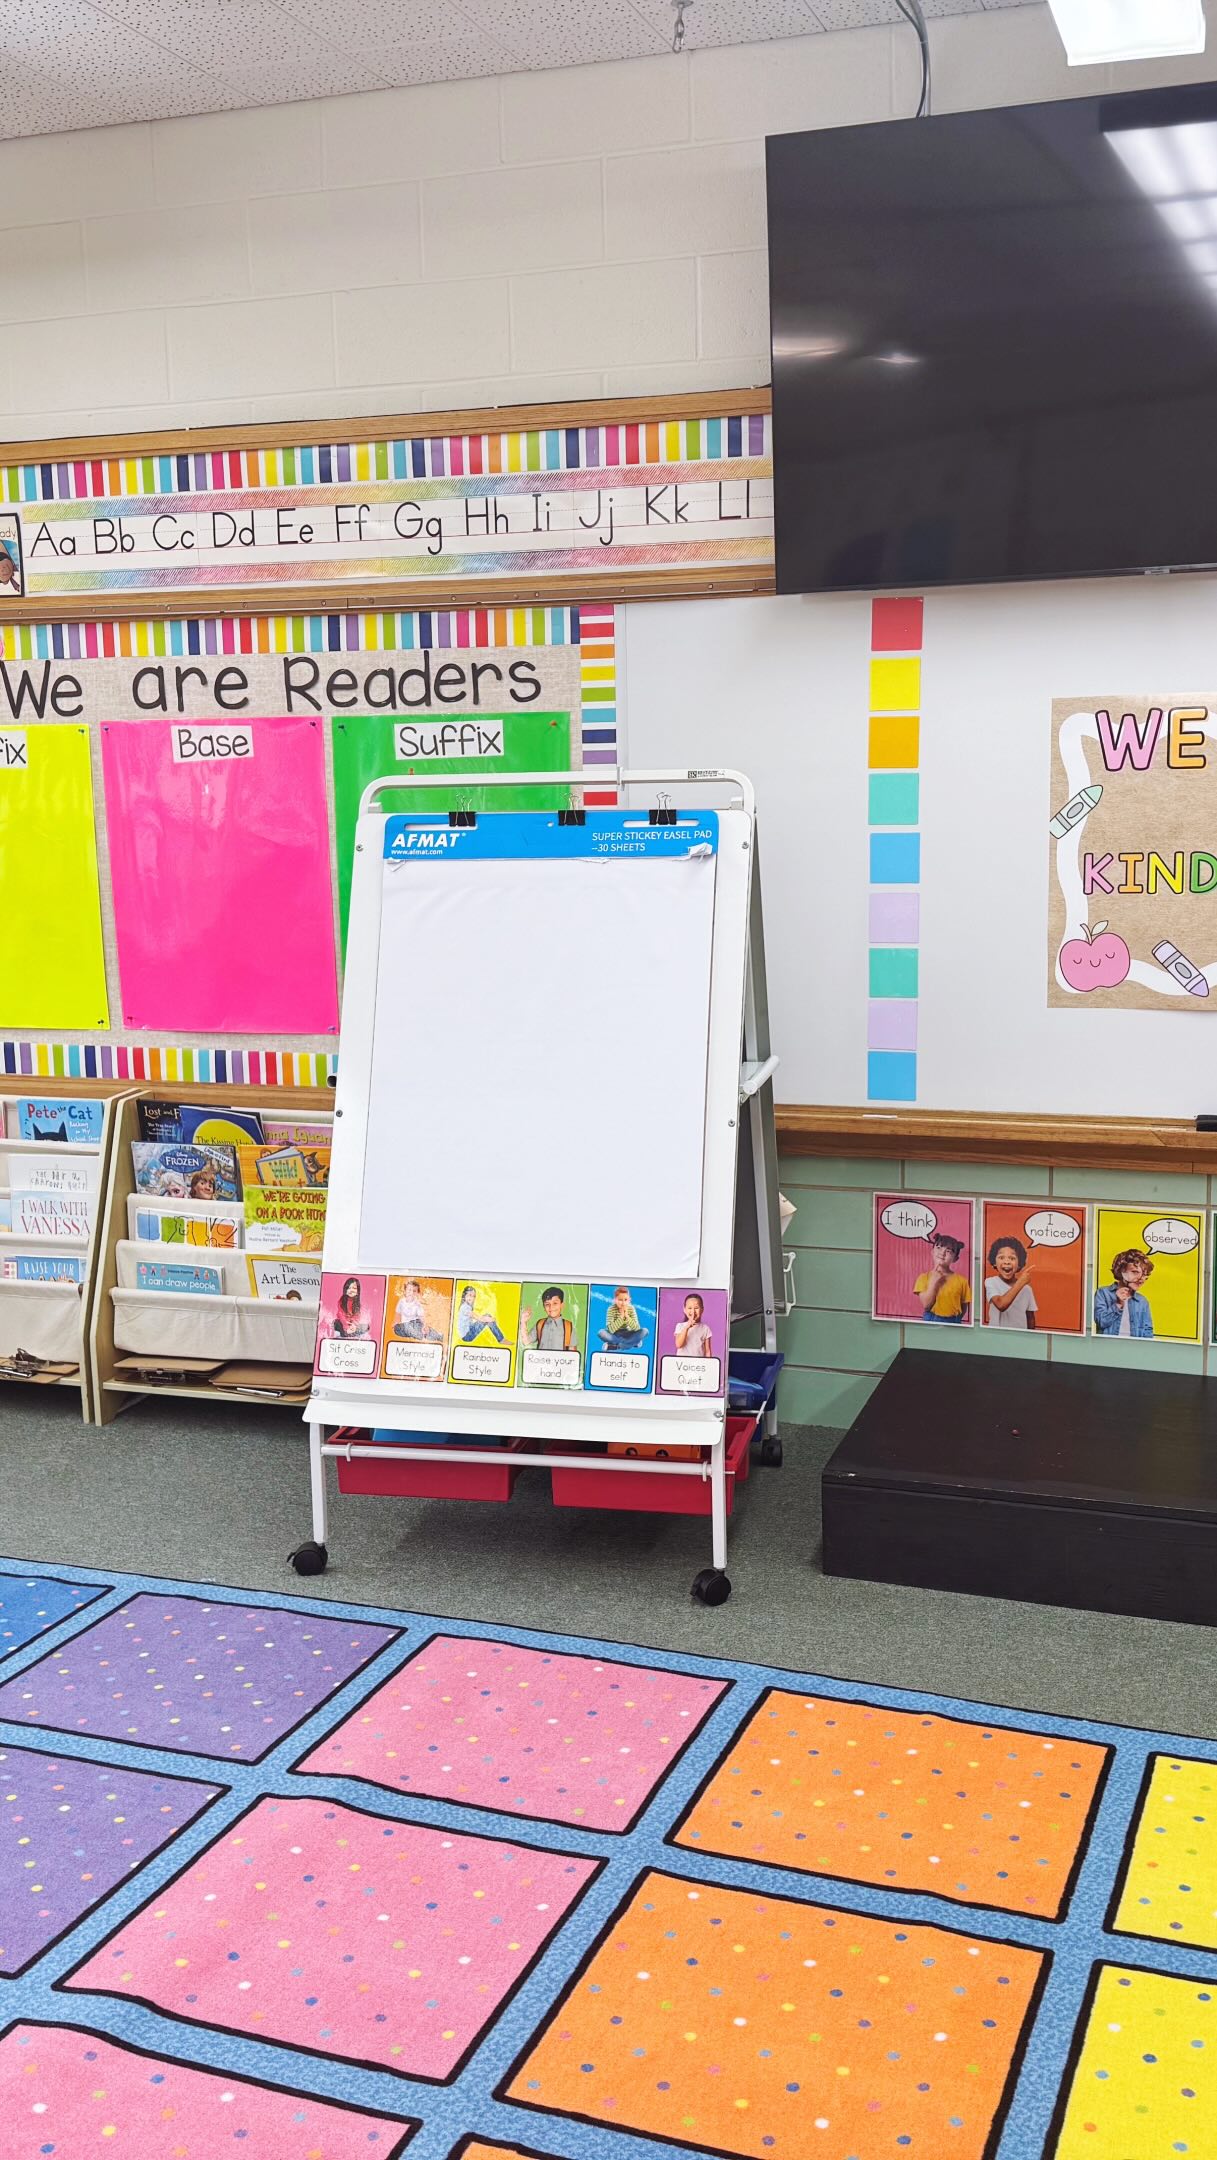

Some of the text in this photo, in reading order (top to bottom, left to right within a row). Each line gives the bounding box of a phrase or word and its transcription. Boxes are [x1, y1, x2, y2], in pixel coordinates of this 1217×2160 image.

[30, 521, 76, 557] Aa
[94, 517, 135, 554] Bb
[152, 514, 195, 551] Cc
[212, 510, 256, 548] Dd
[277, 507, 314, 545] Ee
[335, 504, 370, 542] Ff
[394, 501, 442, 555] Gg
[465, 496, 509, 535] Hh
[532, 493, 551, 532] Ii
[579, 489, 614, 546] Jj
[645, 485, 690, 525] Kk
[0, 650, 542, 719] We are Readers
[177, 728, 250, 759] Base
[399, 723, 502, 757] Suffix
[1095, 706, 1208, 772] WE
[592, 830, 713, 841] SUPER STICKEY EASEL PAD
[610, 842, 646, 852] SHEETS
[1083, 851, 1217, 895] KIND
[27, 1103, 57, 1119] Pete
[68, 1105, 93, 1120] Cat
[144, 1105, 161, 1119] Lost
[165, 1156, 200, 1167] FROZEN
[262, 1190, 326, 1204] WE'RE GOING
[21, 1200, 88, 1217] I WALK WITH
[256, 1207, 269, 1219] ON
[270, 1208, 278, 1220] A
[280, 1208, 305, 1220] BOOK
[21, 1215, 91, 1236] VANESSA
[885, 1210, 934, 1228] I think
[1047, 1213, 1054, 1226] I
[1030, 1226, 1075, 1239] noticed
[1166, 1221, 1173, 1233] I
[1145, 1232, 1198, 1246] observed
[24, 1261, 75, 1276] RAISE YOUR
[279, 1264, 297, 1273] The
[148, 1278, 164, 1286] can
[165, 1278, 188, 1287] draw
[189, 1280, 216, 1292] people
[261, 1273, 320, 1286] Art Lesson
[329, 1343, 367, 1355] Sit Criss
[396, 1347, 435, 1360] Mermaid
[333, 1356, 360, 1368] Cross
[463, 1351, 500, 1362] Rainbow
[528, 1354, 575, 1369] Raise your
[402, 1361, 425, 1372] Style
[469, 1364, 492, 1376] Style
[600, 1359, 641, 1369] Hands to
[676, 1361, 706, 1372] Voices
[540, 1366, 562, 1378] hand
[610, 1371, 629, 1382] self
[678, 1375, 703, 1386] Quiet
